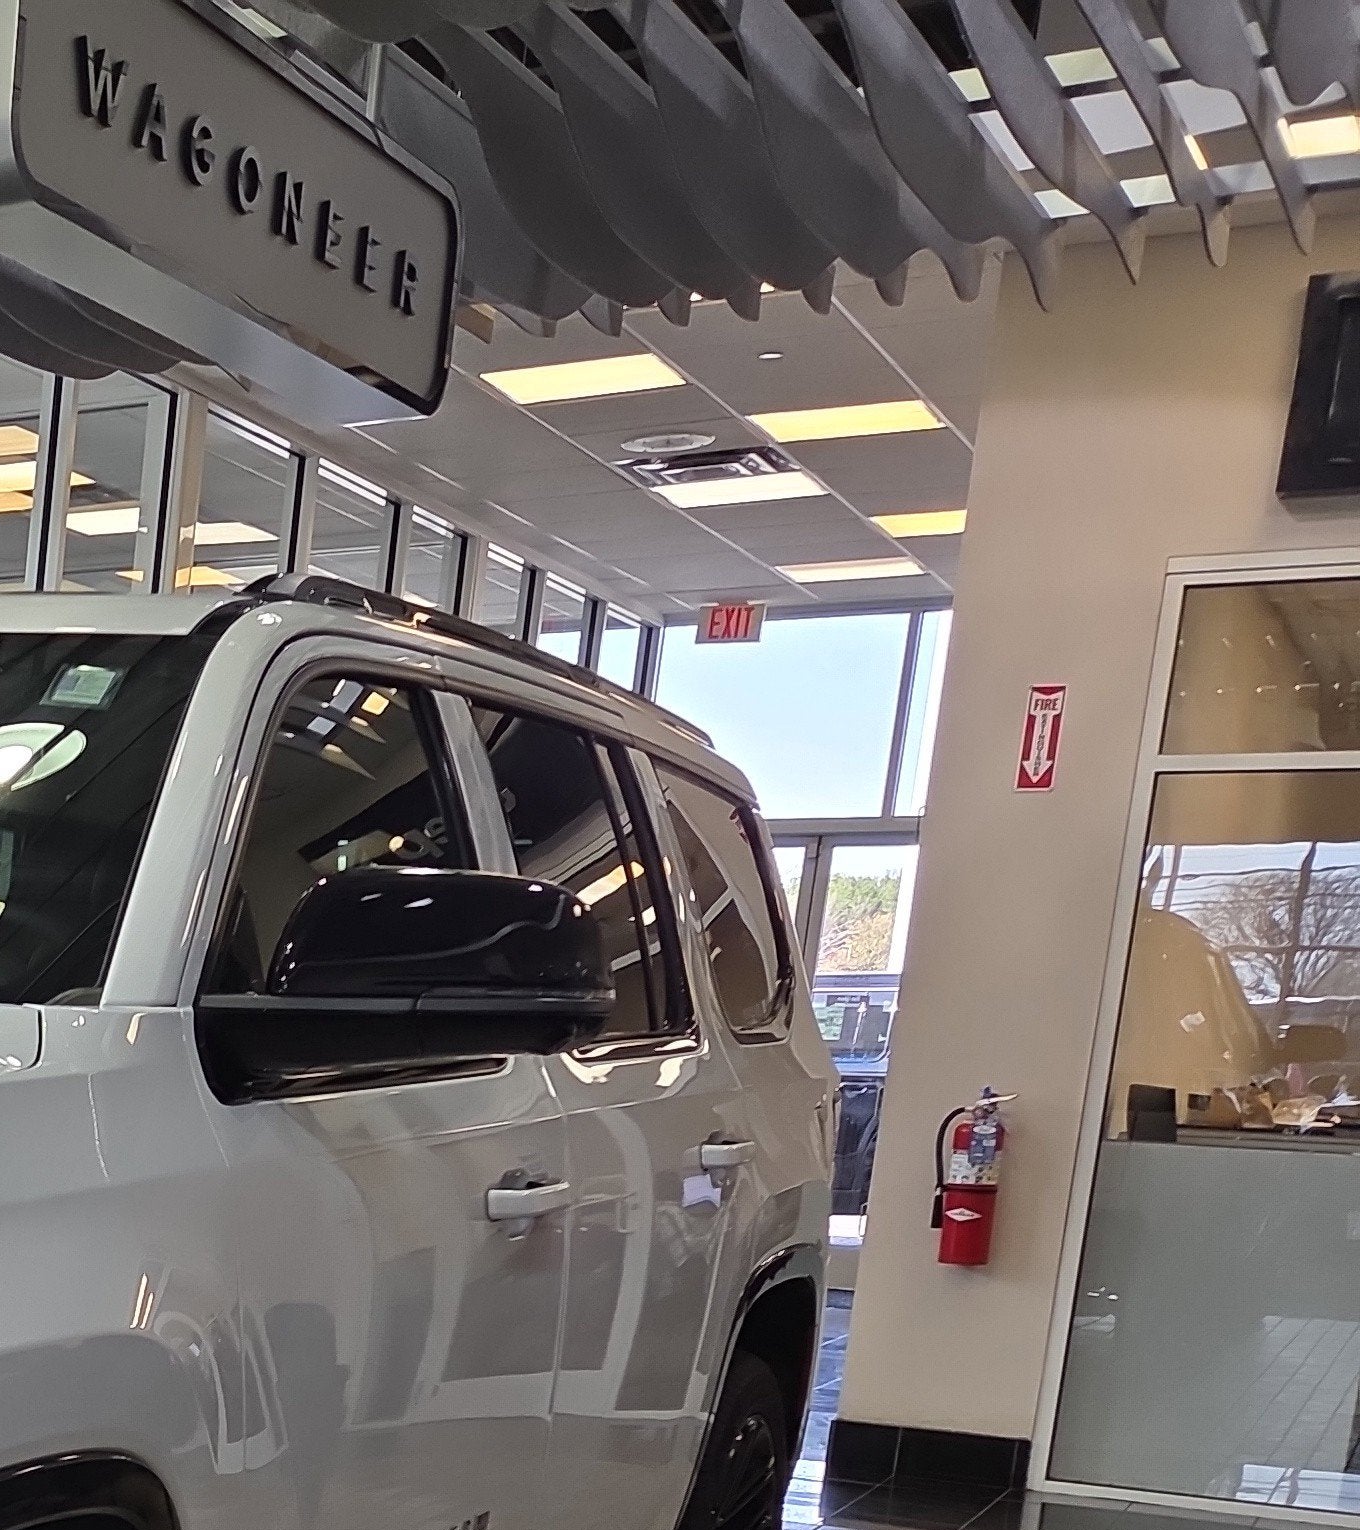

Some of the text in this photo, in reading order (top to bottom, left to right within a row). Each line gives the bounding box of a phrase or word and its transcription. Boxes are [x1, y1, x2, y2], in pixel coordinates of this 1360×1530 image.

[75, 34, 420, 316] WAGONEER
[708, 606, 755, 639] EXIT
[1033, 698, 1059, 711] FIRE
